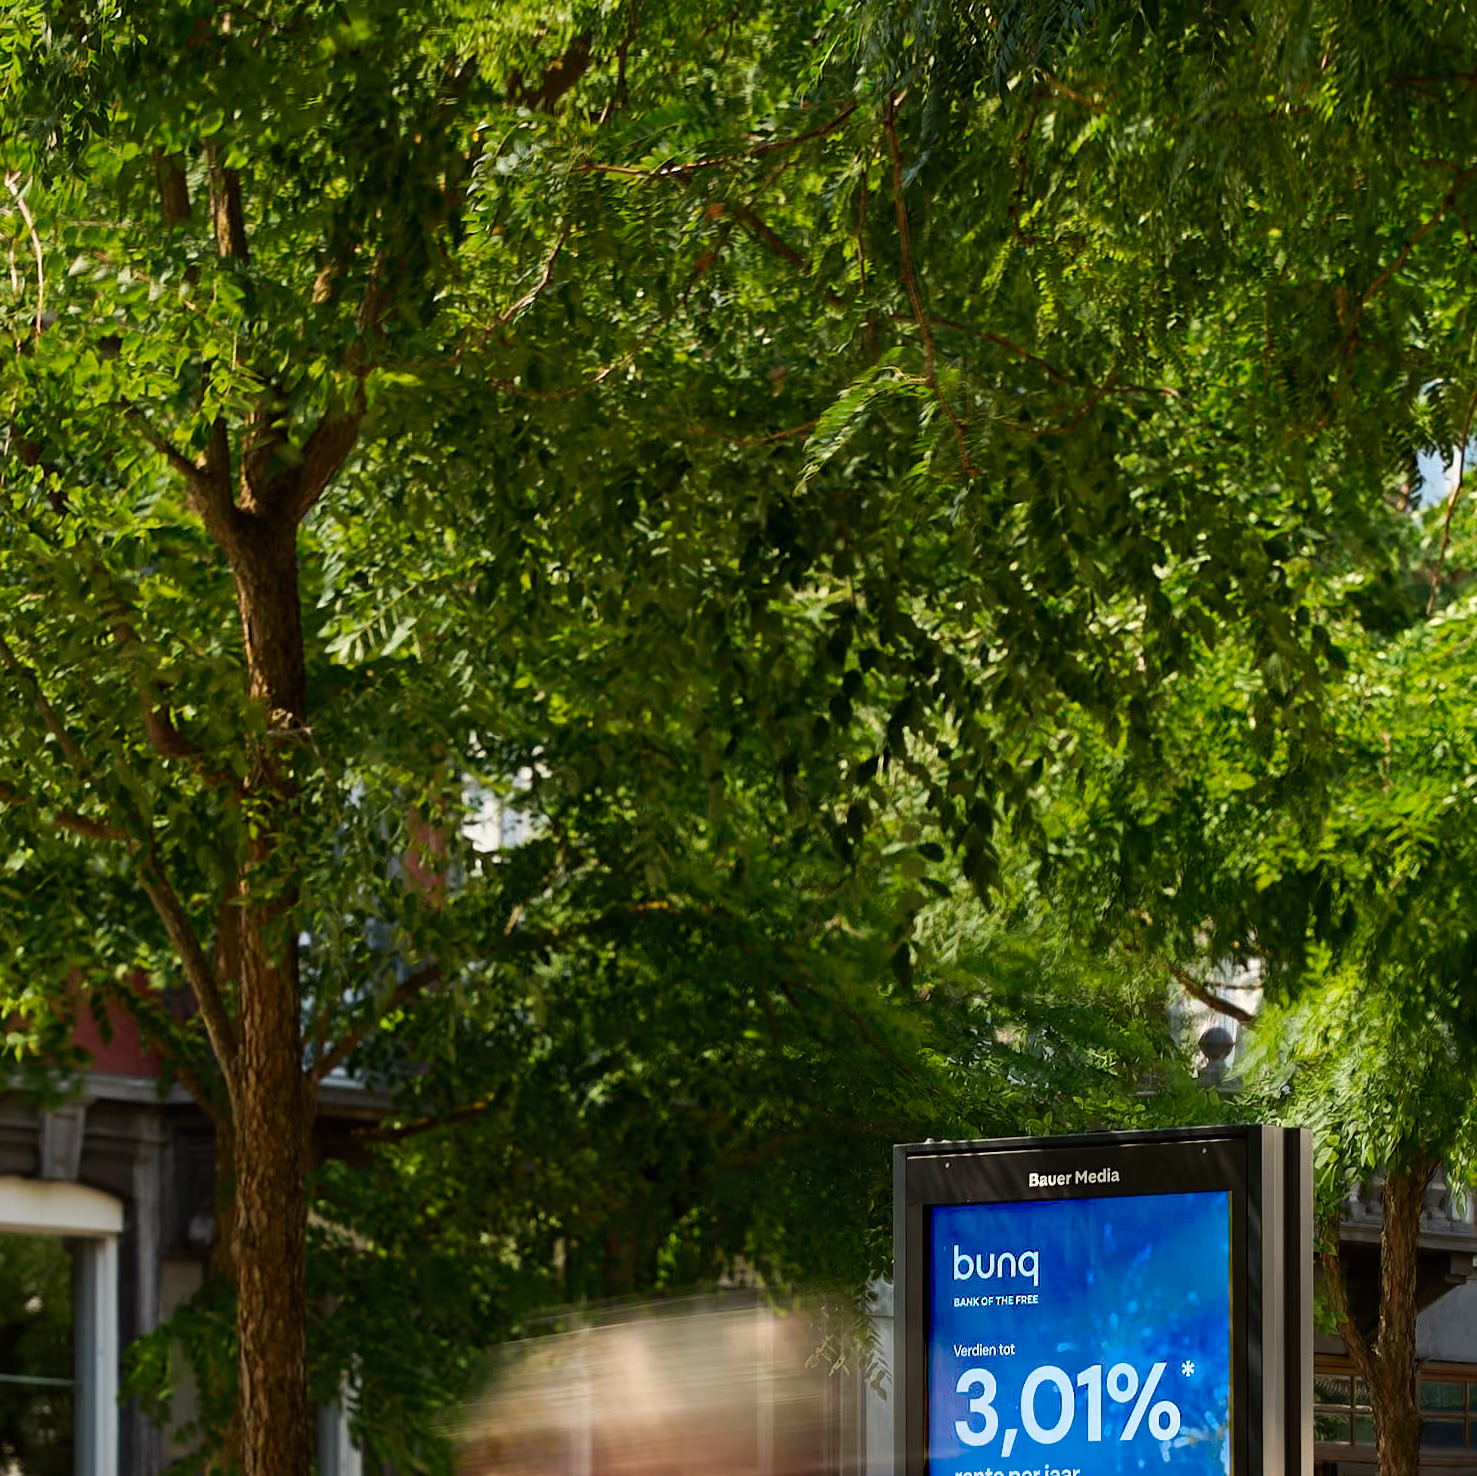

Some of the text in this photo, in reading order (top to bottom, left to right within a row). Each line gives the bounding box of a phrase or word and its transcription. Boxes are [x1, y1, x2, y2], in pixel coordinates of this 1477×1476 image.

[1028, 1167, 1121, 1188] Bauer Media
[953, 1244, 1039, 1287] bunq
[953, 1294, 1039, 1308] BANK OF THE FREE
[953, 1343, 1016, 1358] Verdien tot
